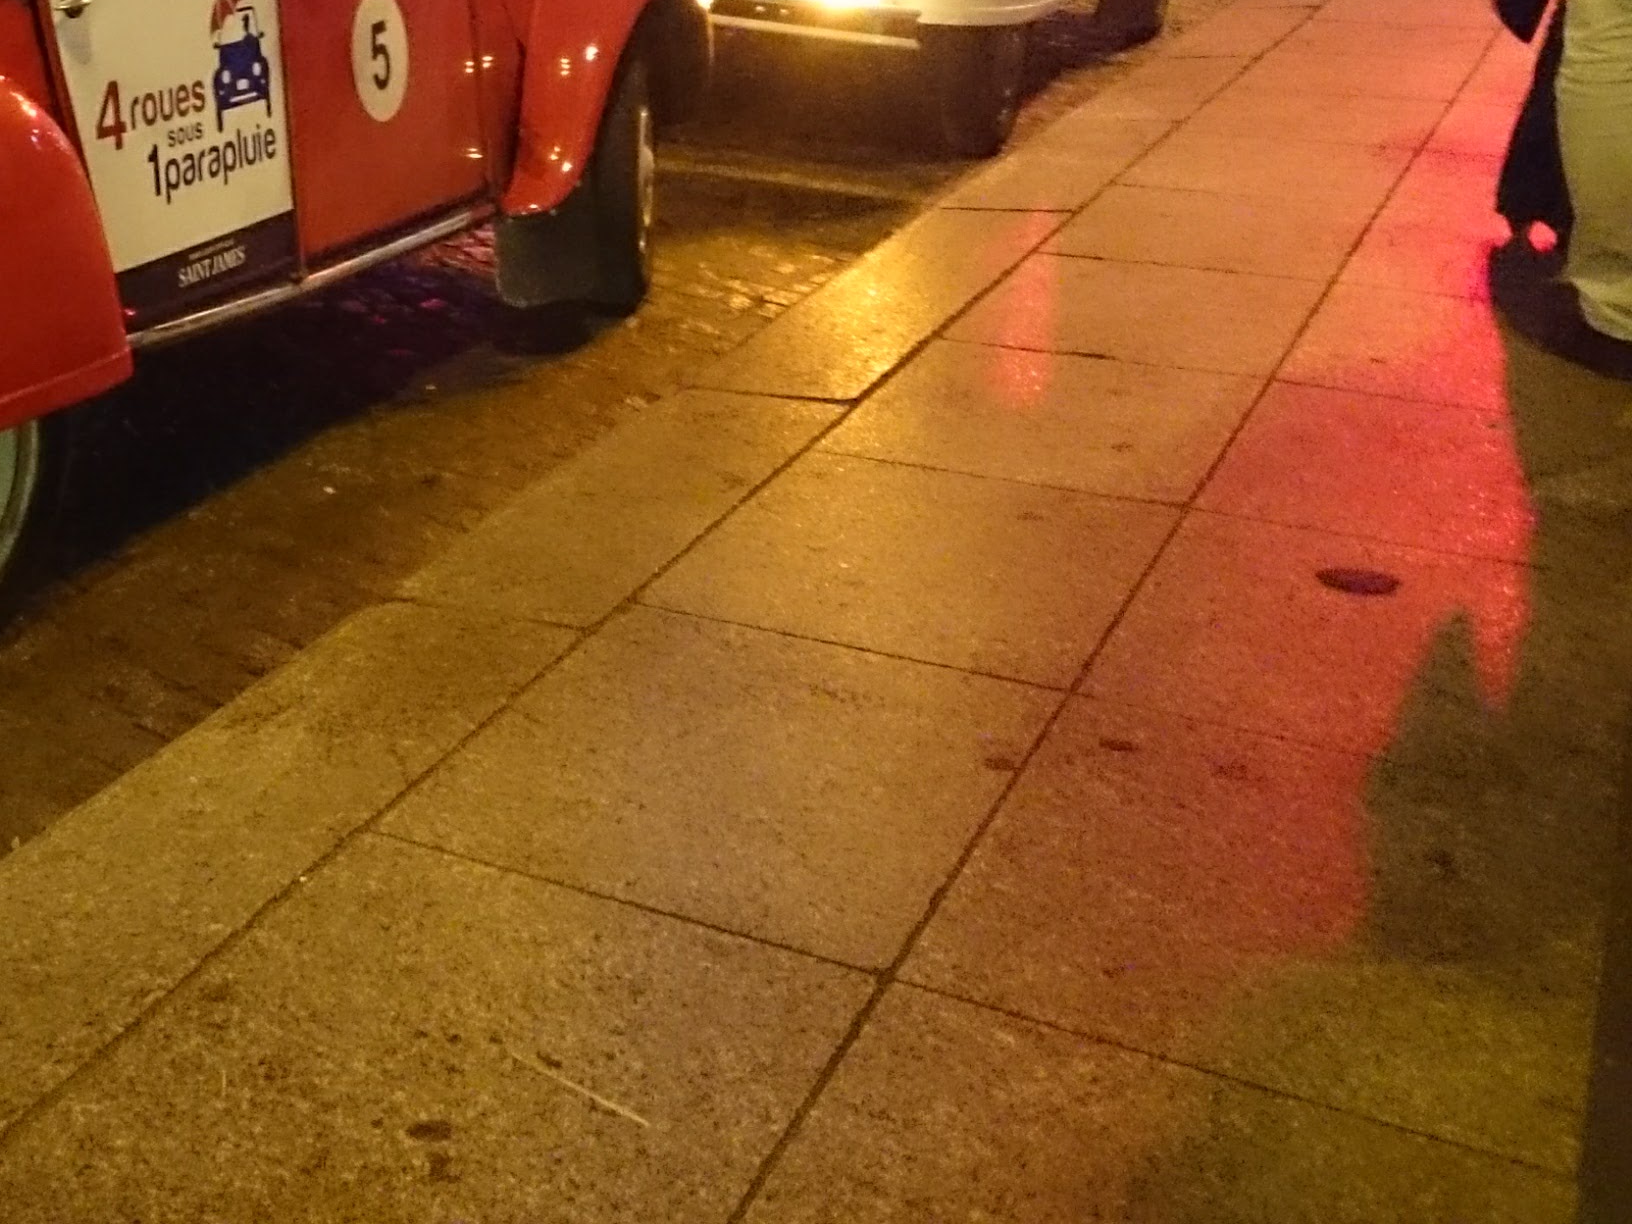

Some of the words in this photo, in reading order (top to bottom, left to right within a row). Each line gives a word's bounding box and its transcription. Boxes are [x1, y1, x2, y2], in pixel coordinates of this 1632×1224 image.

[368, 20, 392, 91] 5
[95, 79, 128, 151] 4
[130, 79, 206, 131] roues
[167, 122, 204, 148] sous
[177, 258, 212, 289] SAINT
